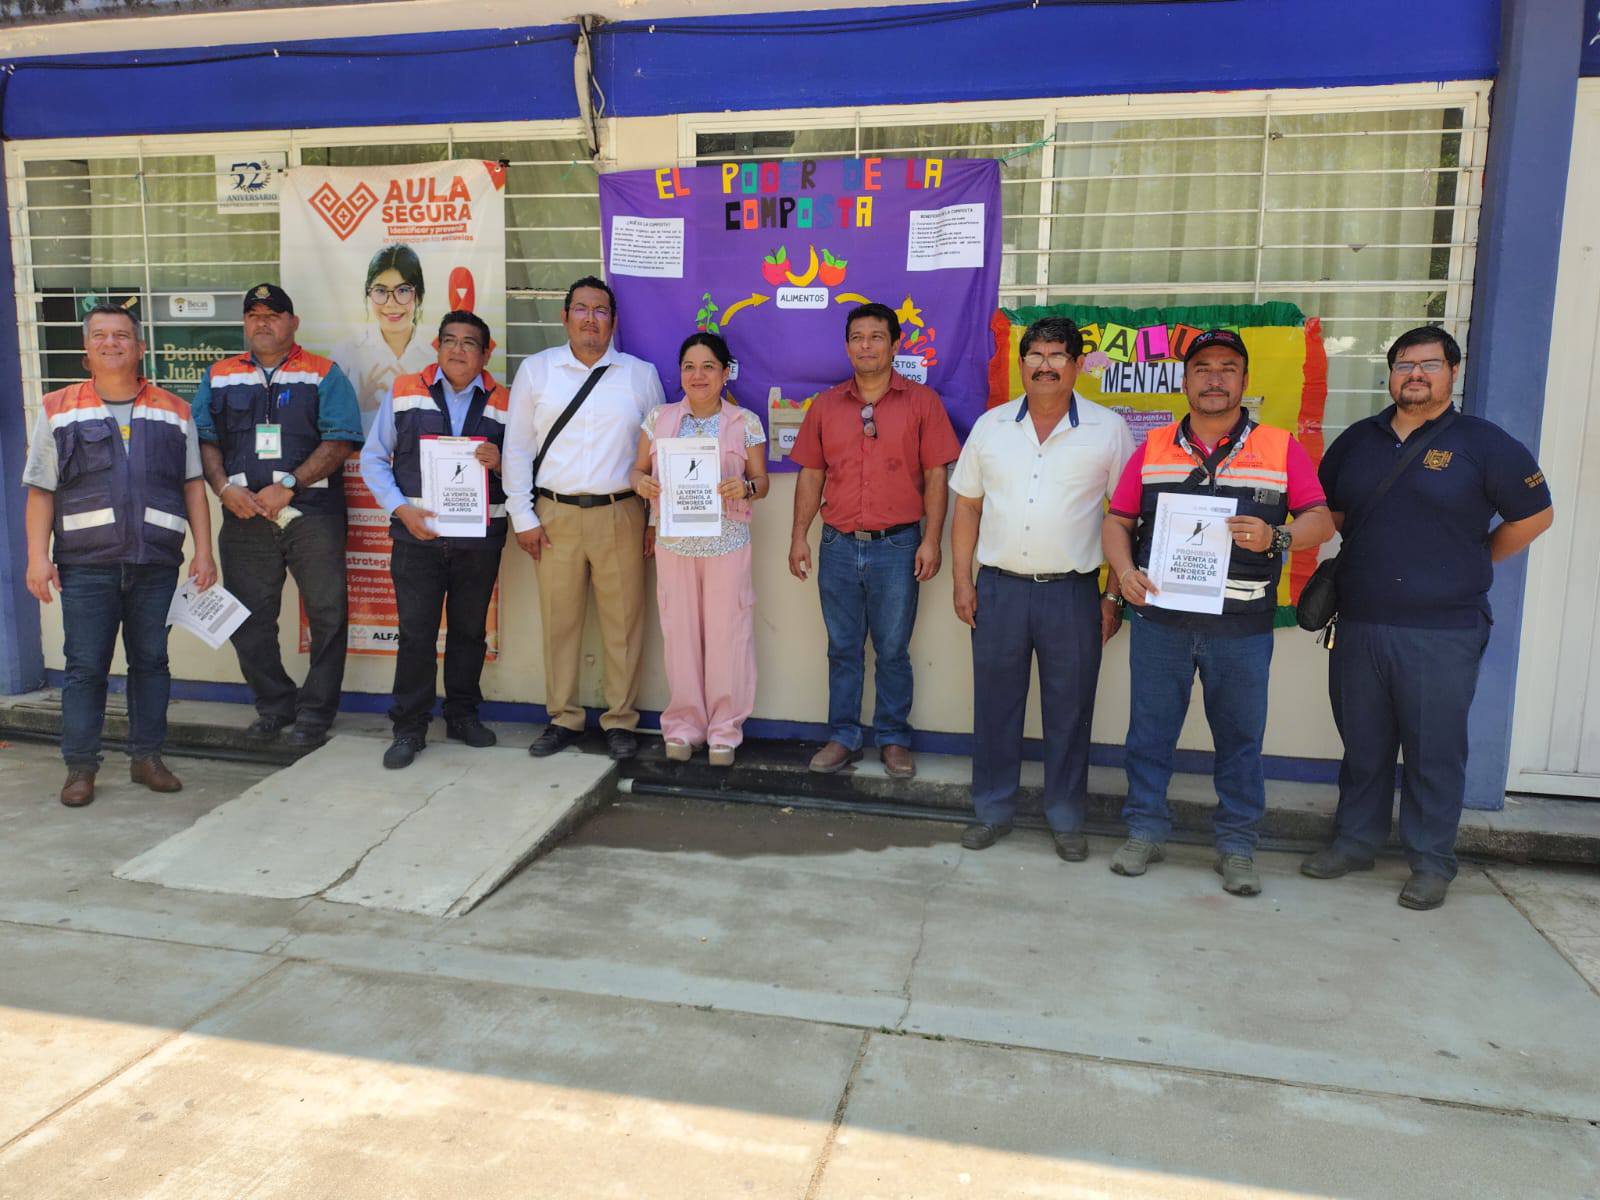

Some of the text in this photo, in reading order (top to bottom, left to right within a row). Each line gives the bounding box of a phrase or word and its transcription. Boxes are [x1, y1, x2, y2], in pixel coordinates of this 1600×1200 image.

[230, 162, 262, 190] 52
[655, 157, 943, 199] EL PODER DE LA
[383, 176, 471, 203] AULA
[226, 194, 278, 202] ANIVERSARIO
[382, 203, 472, 223] SEGURA
[725, 195, 873, 230] COMPOSTA
[780, 294, 825, 303] ALIMENTOS
[1081, 327, 1190, 361] SALU
[163, 343, 225, 361] Benito
[893, 360, 917, 369] STOS
[163, 362, 206, 380] Juár
[1104, 361, 1182, 393] MENTAL
[350, 513, 387, 522] ntorno
[347, 556, 390, 568] strategi
[1183, 555, 1206, 563] VENTA
[1170, 567, 1206, 575] MENORES
[1173, 561, 1208, 570] ALCOHOL
[358, 596, 397, 605] protocolo
[372, 632, 399, 641] ALFA
